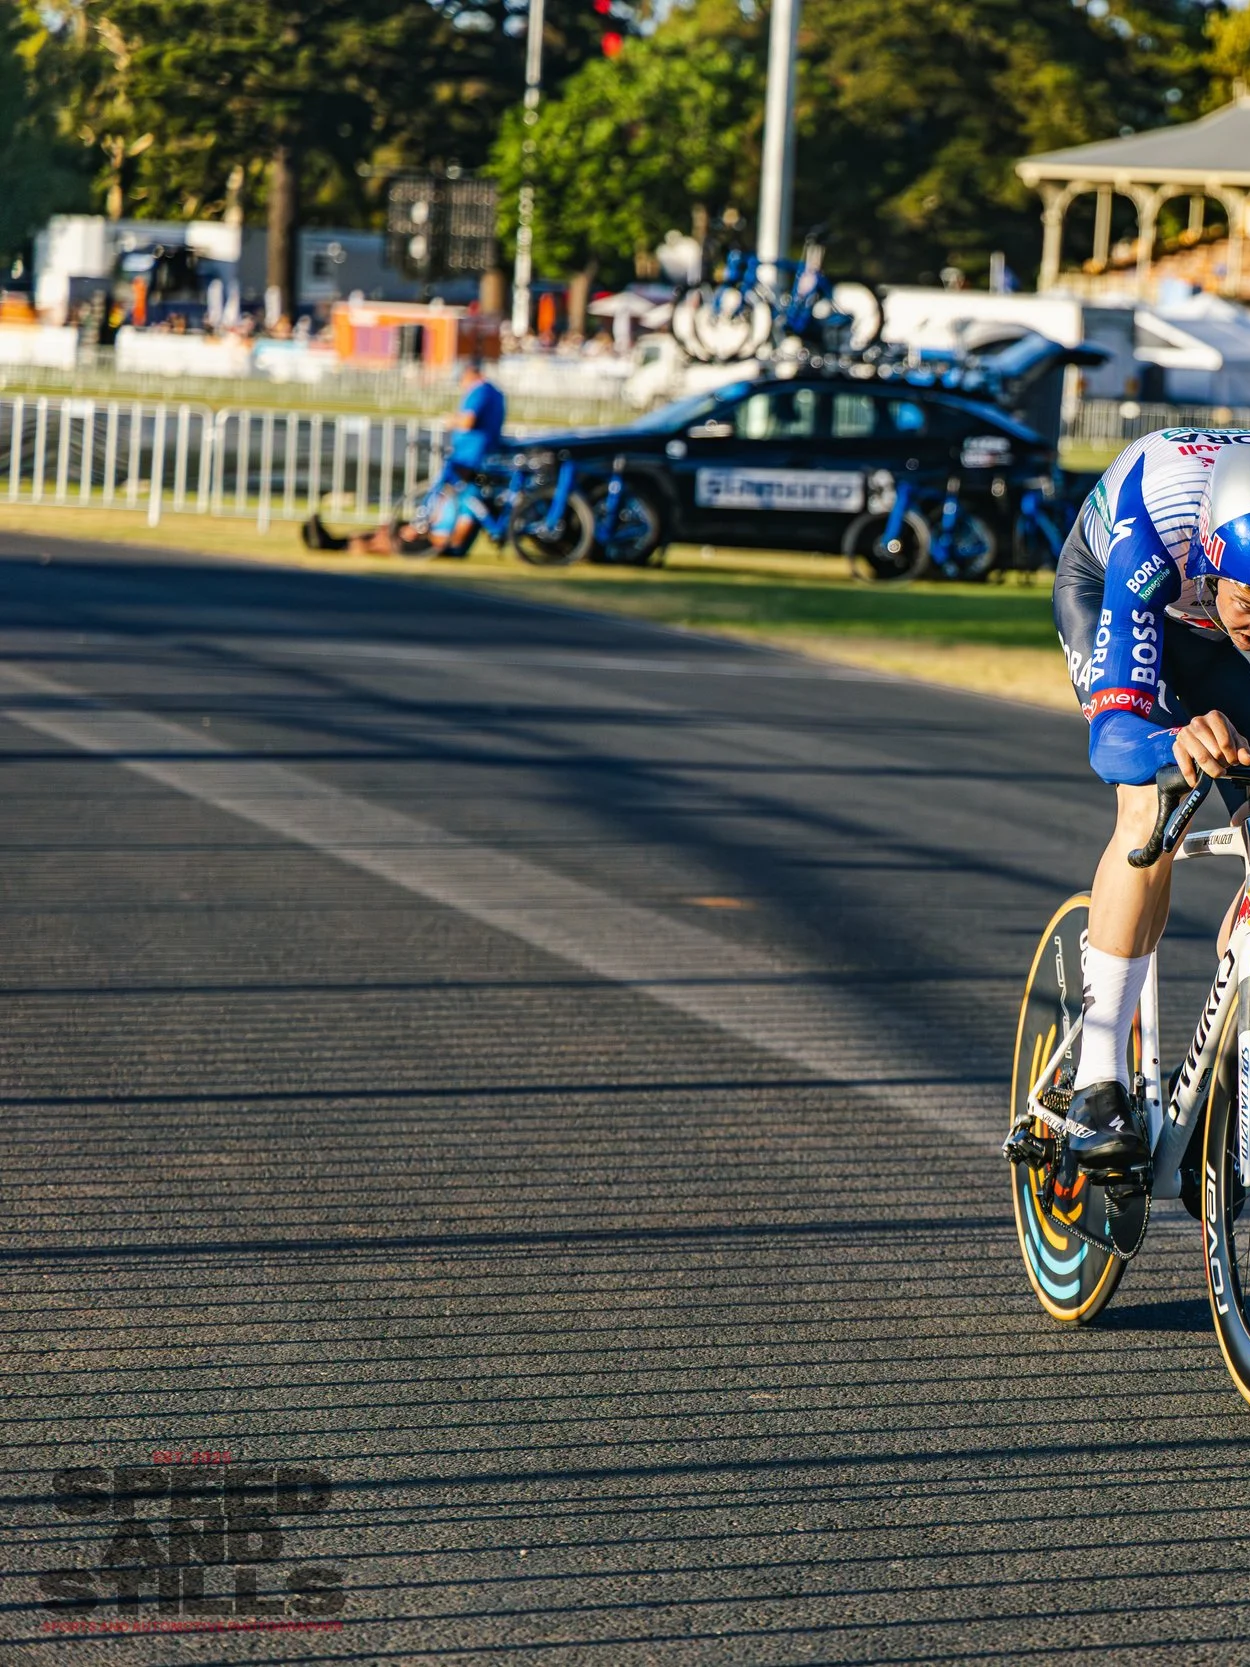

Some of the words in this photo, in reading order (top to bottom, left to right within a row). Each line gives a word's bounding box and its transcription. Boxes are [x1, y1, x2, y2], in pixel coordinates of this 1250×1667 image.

[1125, 553, 1166, 594] BORA
[1139, 567, 1171, 600] hansgrohe
[1091, 608, 1112, 685] BORA
[1131, 609, 1157, 686] BOSS
